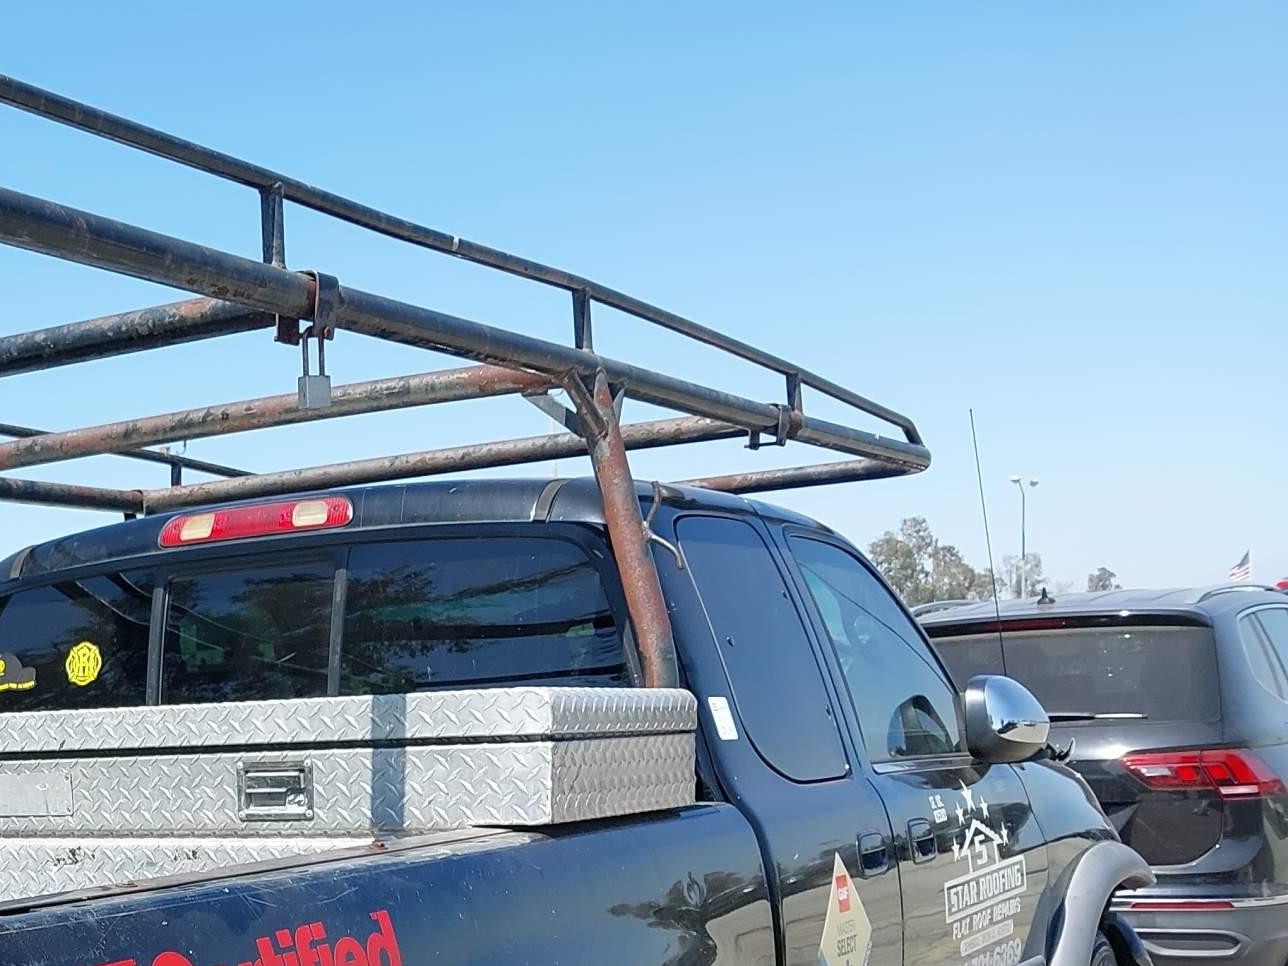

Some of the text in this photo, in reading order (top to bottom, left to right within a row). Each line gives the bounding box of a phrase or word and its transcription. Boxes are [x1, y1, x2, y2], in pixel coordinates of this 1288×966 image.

[974, 834, 988, 865] 5
[950, 864, 1022, 912] STAR ROOFING
[952, 918, 971, 941] FLAT
[973, 909, 992, 931] ROOF
[836, 934, 858, 958] SELECT
